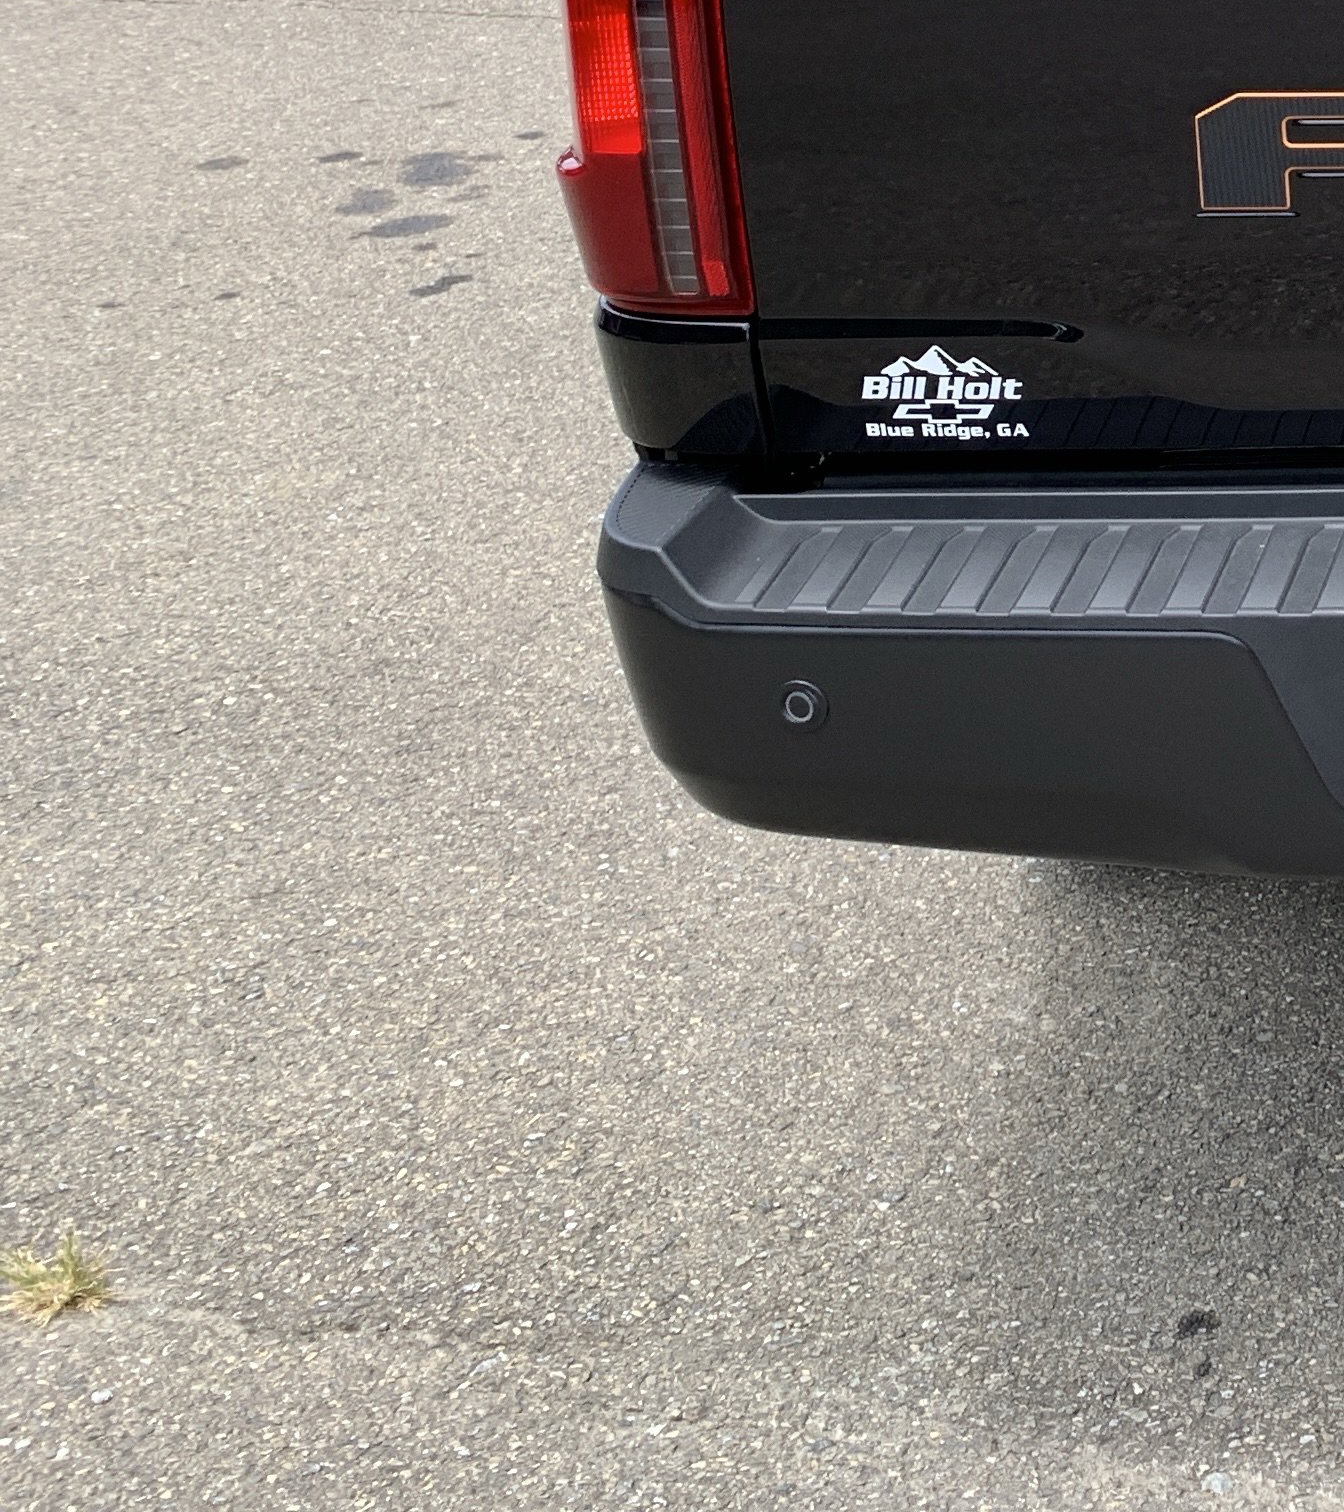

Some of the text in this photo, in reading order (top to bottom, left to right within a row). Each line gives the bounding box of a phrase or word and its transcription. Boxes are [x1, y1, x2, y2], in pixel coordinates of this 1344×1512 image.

[861, 375, 1023, 400] Bill Holt
[865, 422, 1030, 440] Blue Ridge, GA
